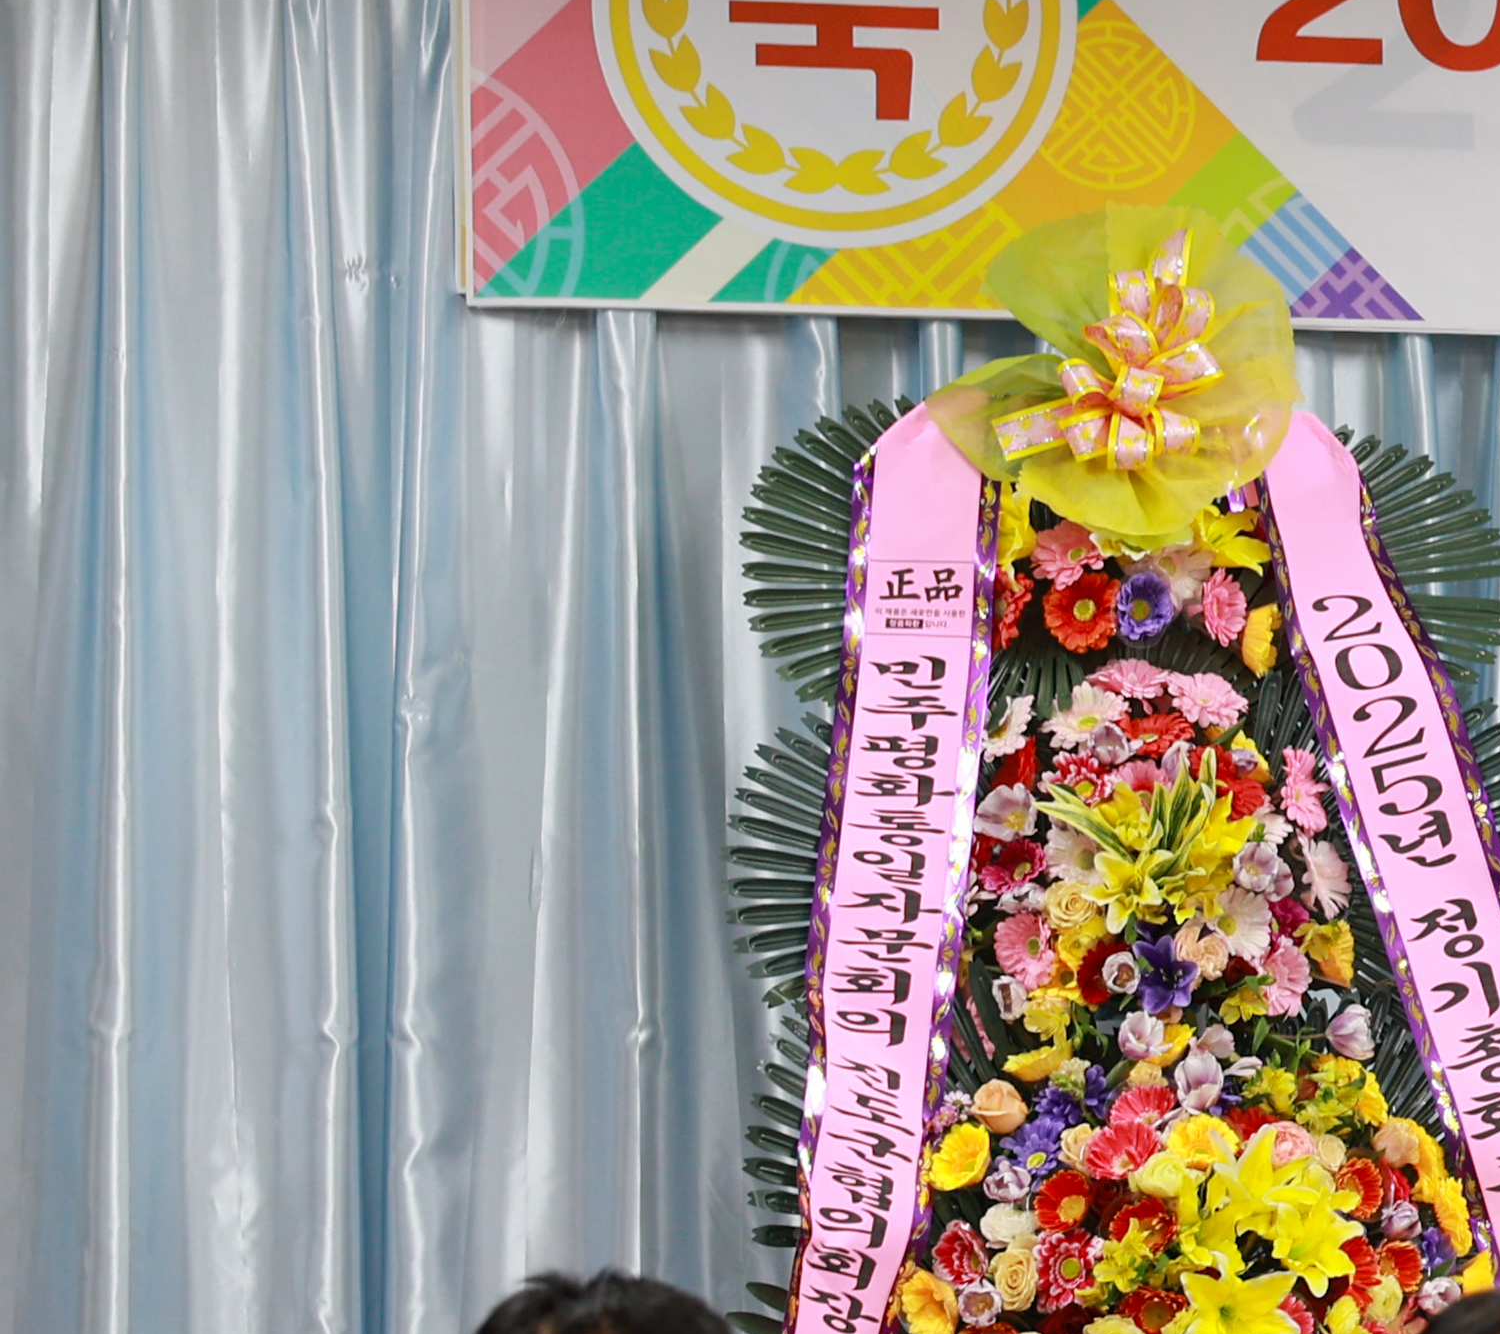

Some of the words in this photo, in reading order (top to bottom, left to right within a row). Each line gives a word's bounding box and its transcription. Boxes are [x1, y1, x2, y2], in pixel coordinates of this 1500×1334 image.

[879, 568, 963, 603] 正品
[830, 654, 960, 1048] 민주평화통일자문회의
[1311, 593, 1458, 868] 2025년
[801, 1055, 916, 1334] 진도군협의회장
